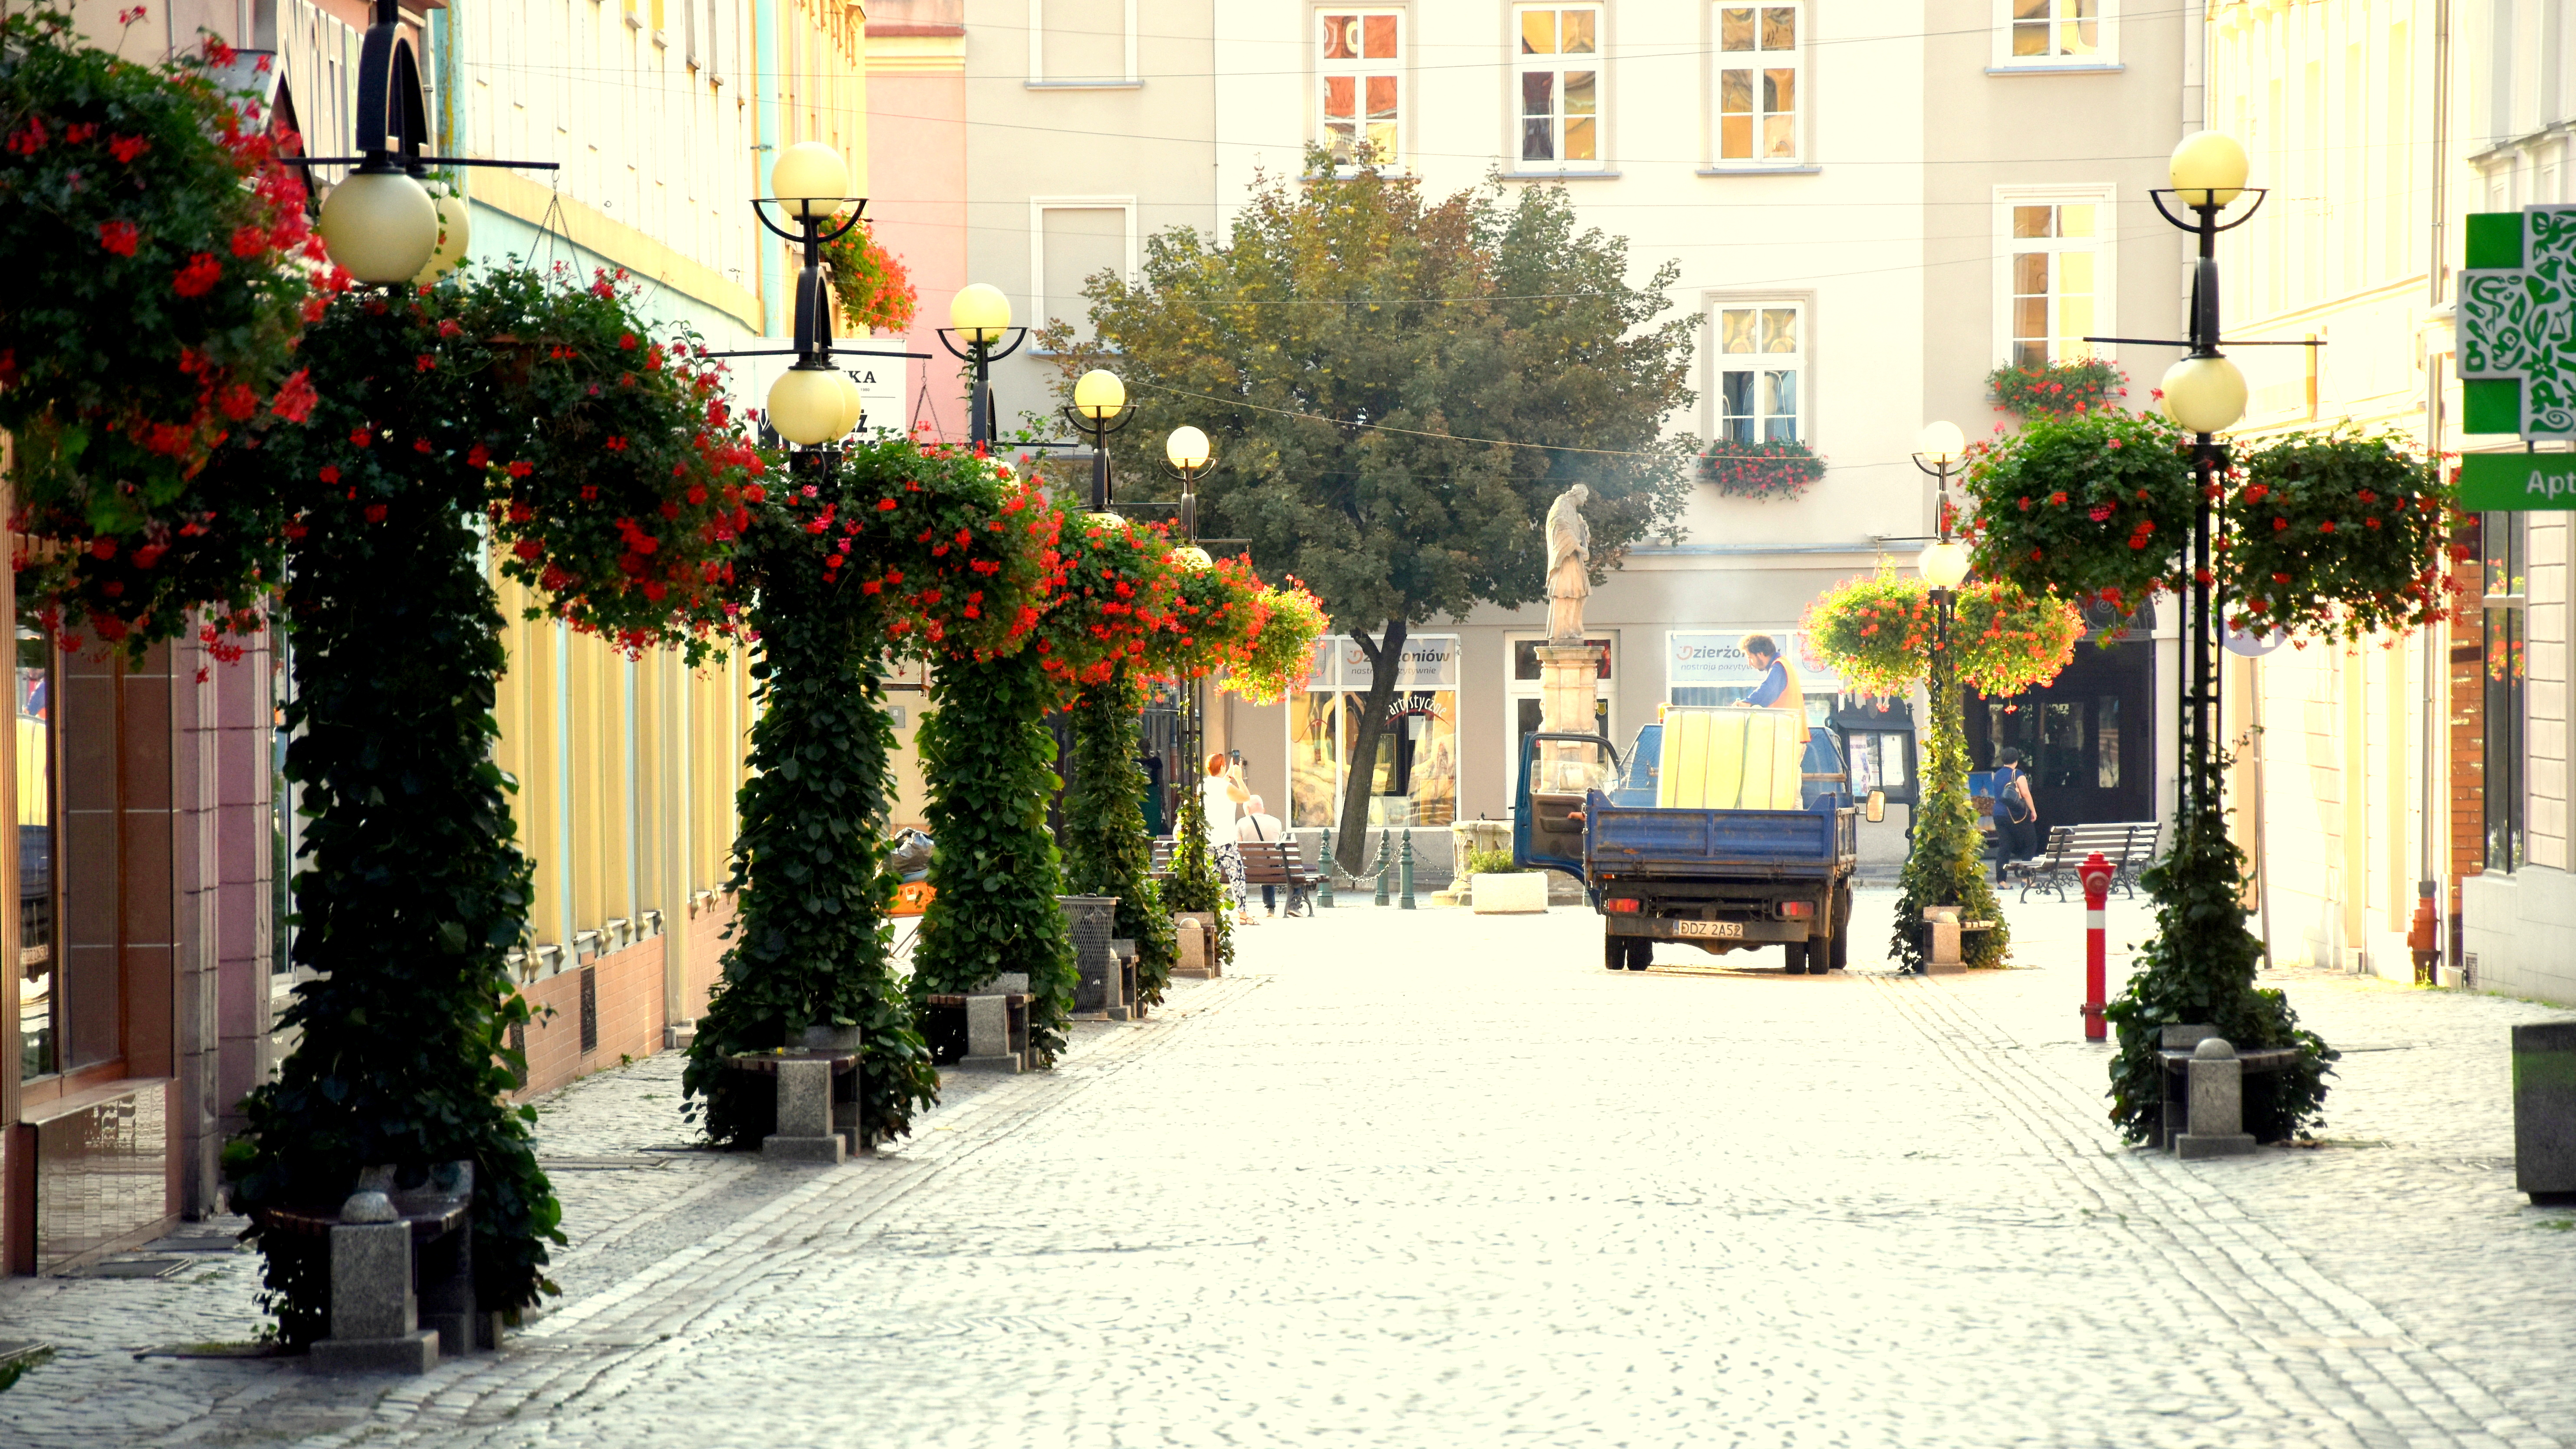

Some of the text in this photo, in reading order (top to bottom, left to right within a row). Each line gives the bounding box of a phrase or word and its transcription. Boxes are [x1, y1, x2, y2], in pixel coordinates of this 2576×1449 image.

[1347, 649, 1450, 665] Dzoniów
[1681, 663, 1716, 671] nastraja
[1389, 695, 1447, 717] artystyczne
[1681, 922, 1741, 937] DDZ 2A52
